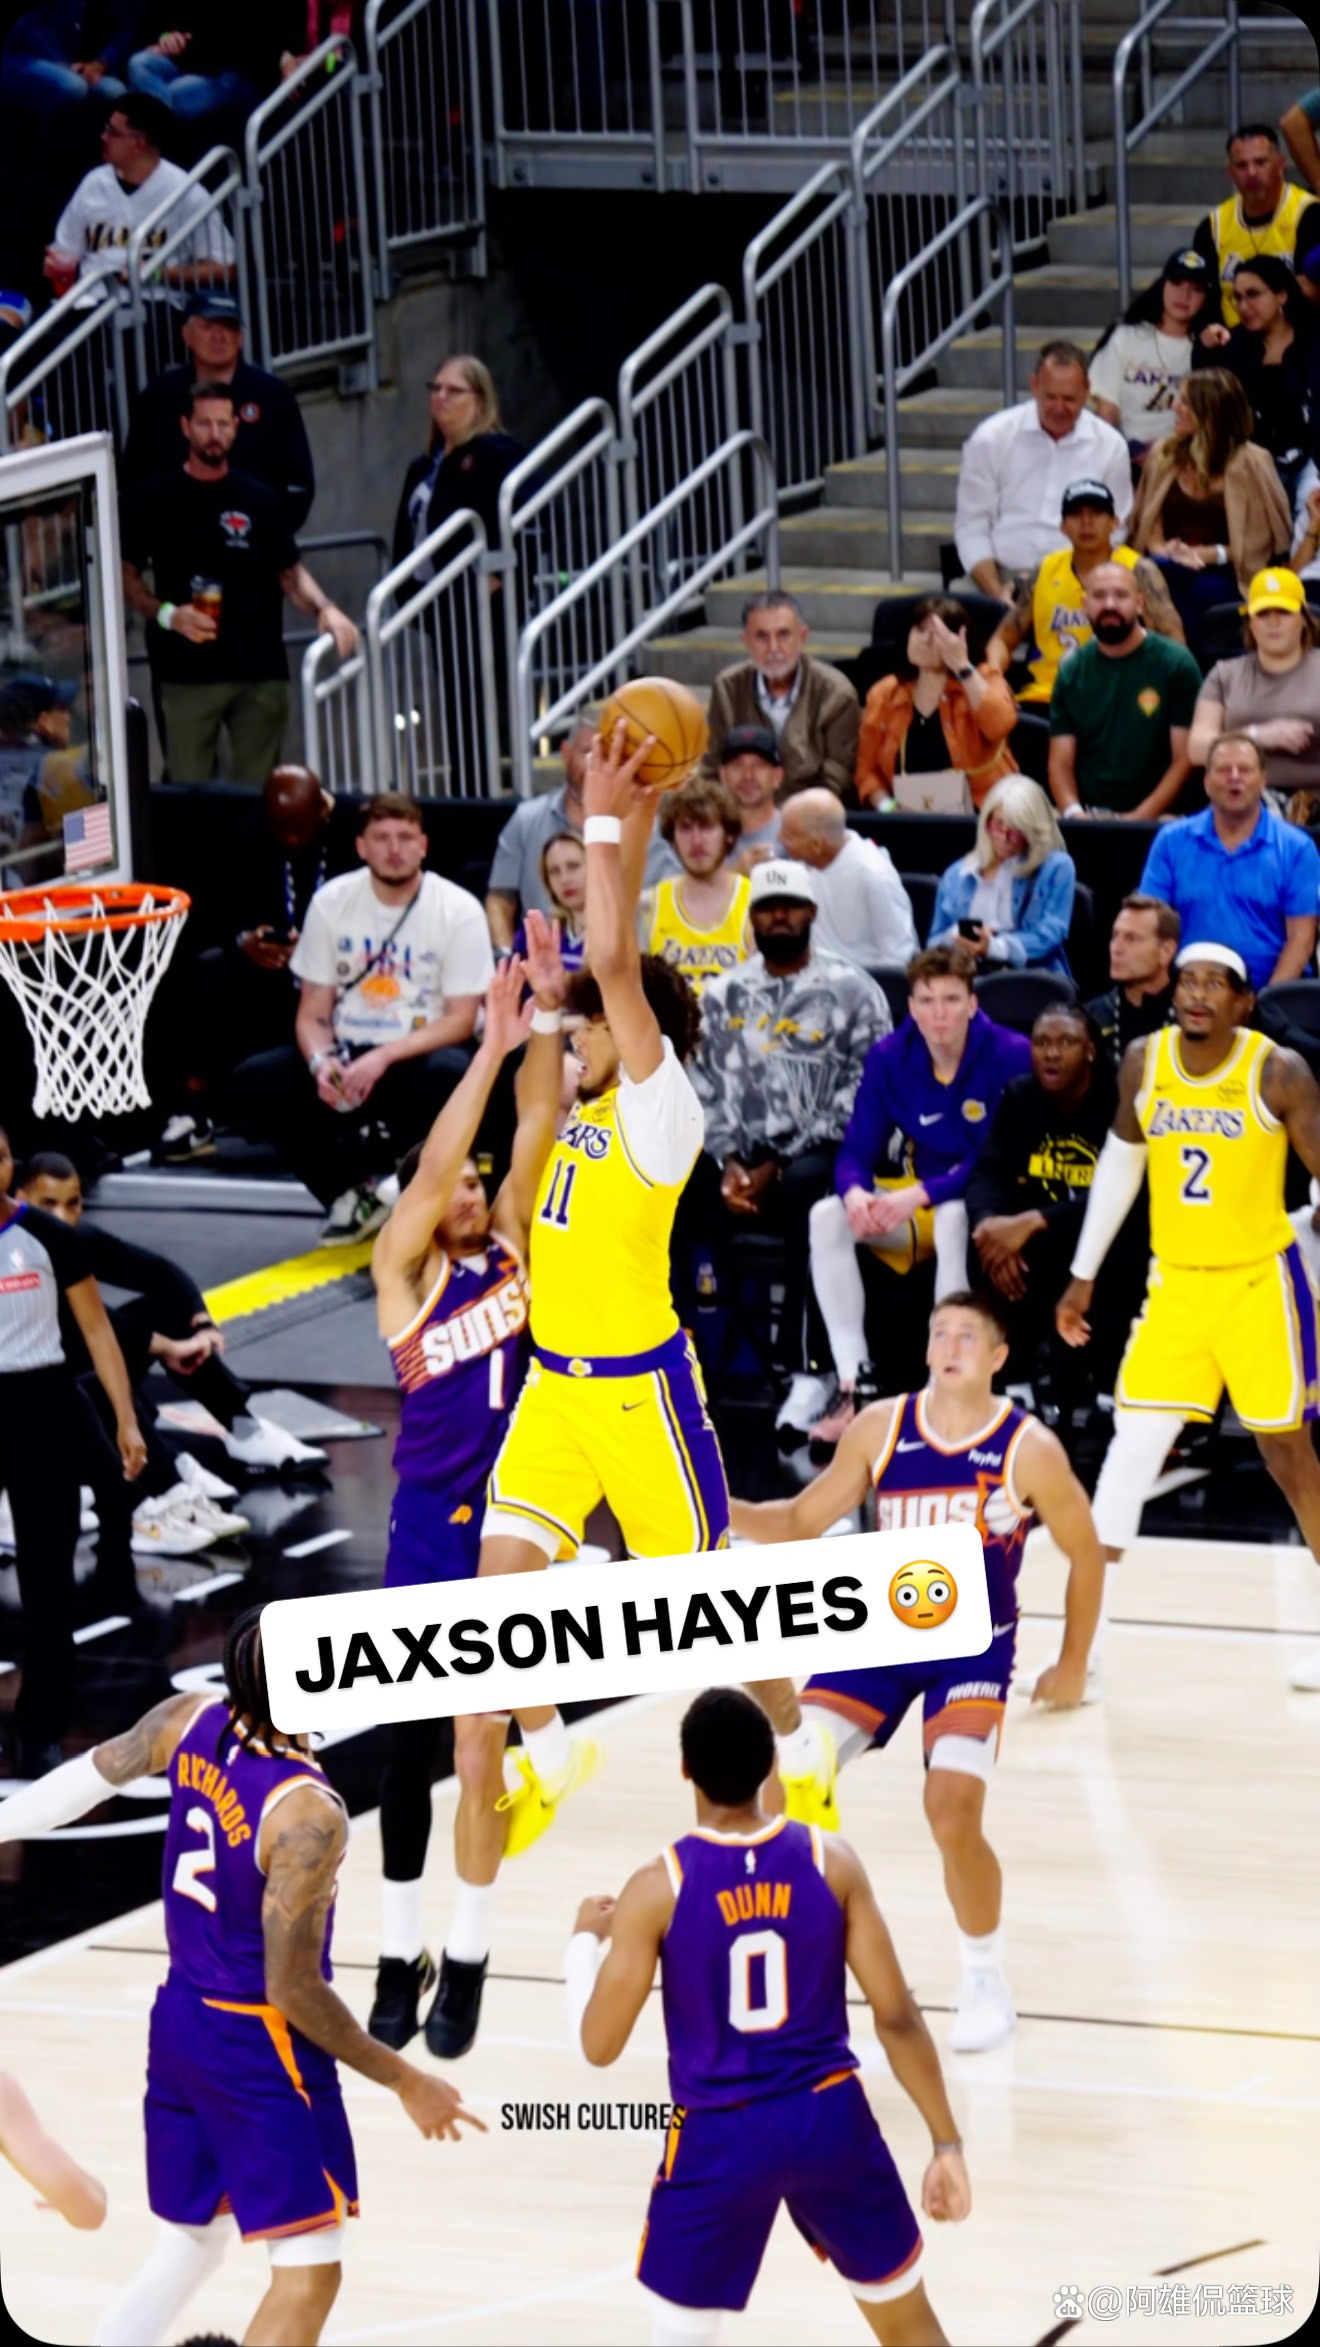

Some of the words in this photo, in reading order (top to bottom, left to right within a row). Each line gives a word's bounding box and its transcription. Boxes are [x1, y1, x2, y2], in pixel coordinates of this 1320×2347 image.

[1149, 1100, 1244, 1139] LAKERS
[540, 1158, 577, 1227] 11
[1182, 1147, 1211, 1201] 2
[421, 1280, 527, 1376] SUNS
[488, 1347, 505, 1410] 1
[178, 1752, 252, 1848] RICHARDS
[172, 1806, 217, 1913] 2
[716, 1881, 791, 1927] DUNN
[728, 1929, 789, 2034] 0
